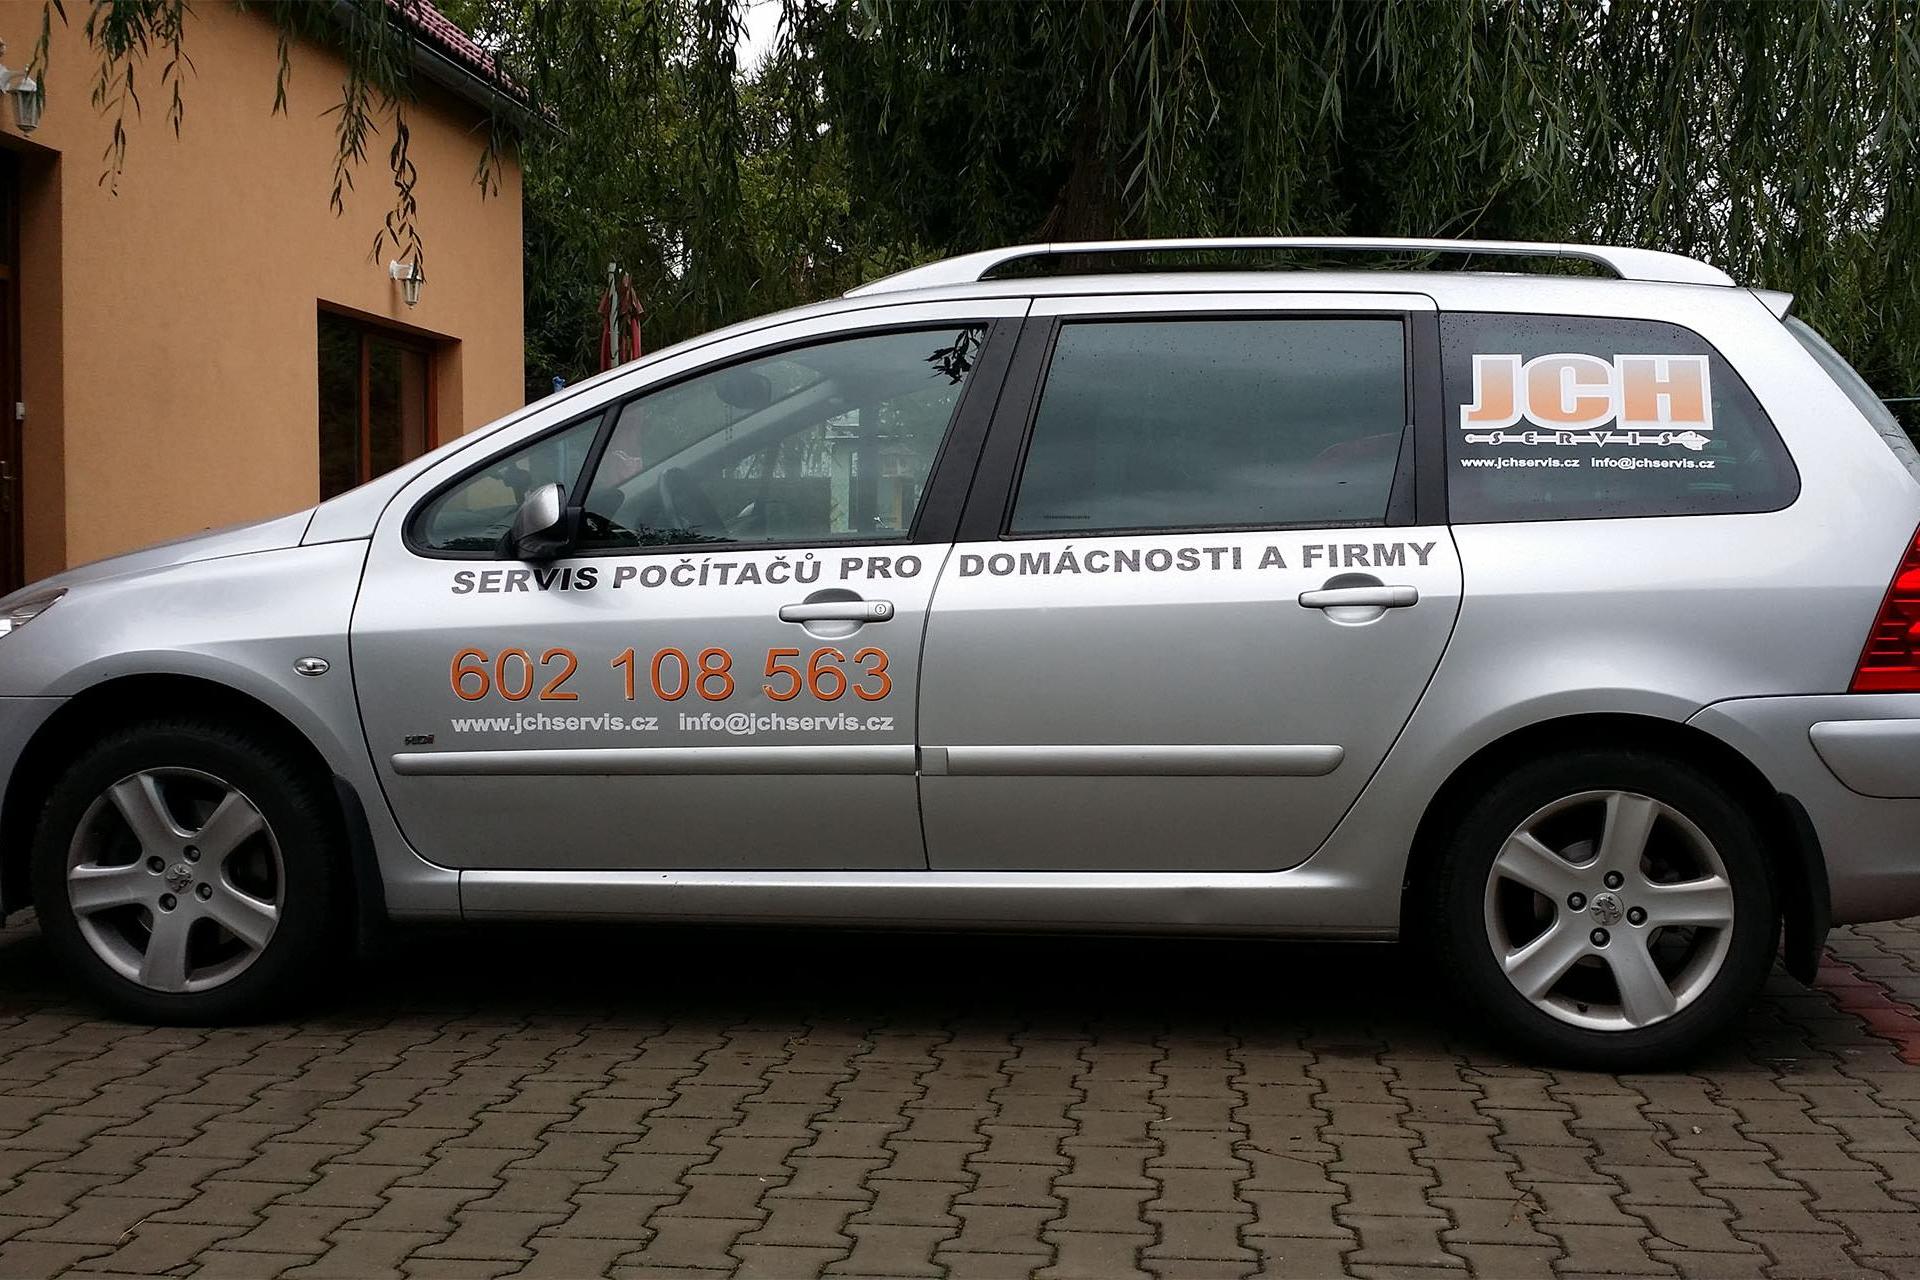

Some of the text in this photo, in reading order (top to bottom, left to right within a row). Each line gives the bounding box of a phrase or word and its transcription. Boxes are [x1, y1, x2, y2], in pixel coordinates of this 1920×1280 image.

[1460, 353, 1713, 430] JCH
[1490, 431, 1672, 446] SERVIS
[1461, 457, 1580, 469] www.jchservis.cz
[451, 541, 1436, 594] SERVIS POČÍTAČŮ PRO DOMÁCNOSTI A FIRMY
[449, 648, 893, 701] 602 108 563
[451, 712, 895, 735] www.jchservis.cz info@jchservis.cz
